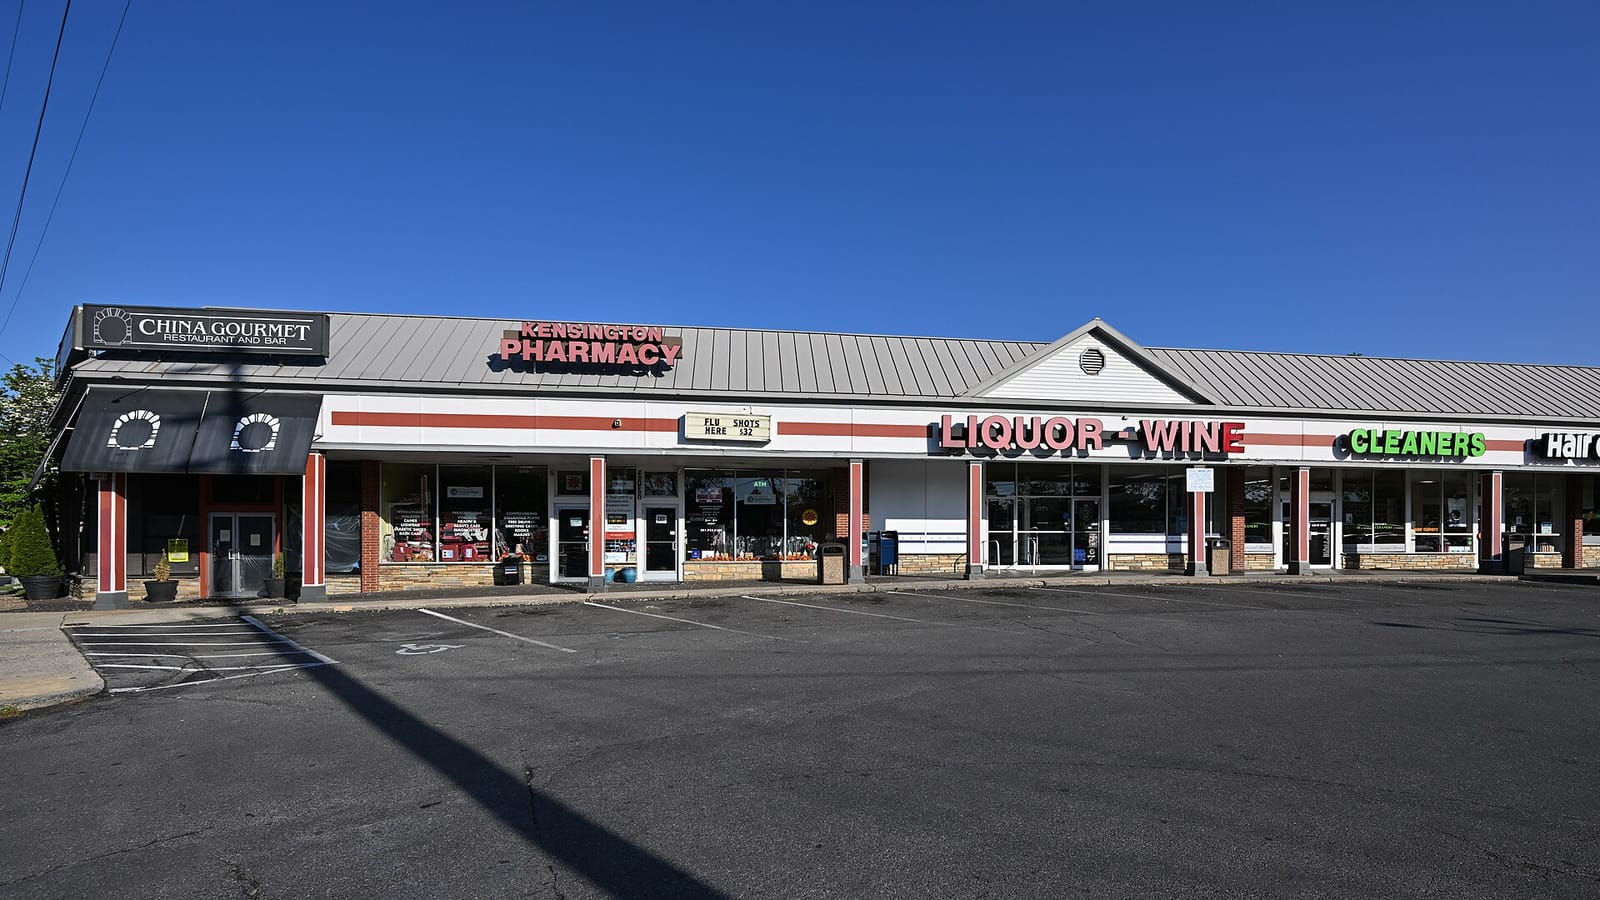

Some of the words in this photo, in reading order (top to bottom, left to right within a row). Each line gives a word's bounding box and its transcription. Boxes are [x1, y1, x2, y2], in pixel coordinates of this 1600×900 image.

[138, 318, 205, 336] CHINA
[210, 321, 310, 341] GOURMET
[163, 333, 236, 343] RESTAURANT
[238, 335, 261, 344] AND
[264, 336, 287, 345] BAR
[521, 321, 663, 342] KENSINGTON
[501, 338, 681, 366] PHARMACY
[704, 417, 720, 427] FLU
[733, 419, 760, 428] SHOTS
[704, 426, 727, 435] HERE
[739, 428, 753, 436] $32
[941, 414, 1104, 451] LIQUOR
[1140, 419, 1246, 454] WINE
[1350, 427, 1486, 457] CLEANERS
[1546, 432, 1590, 459] Hair
